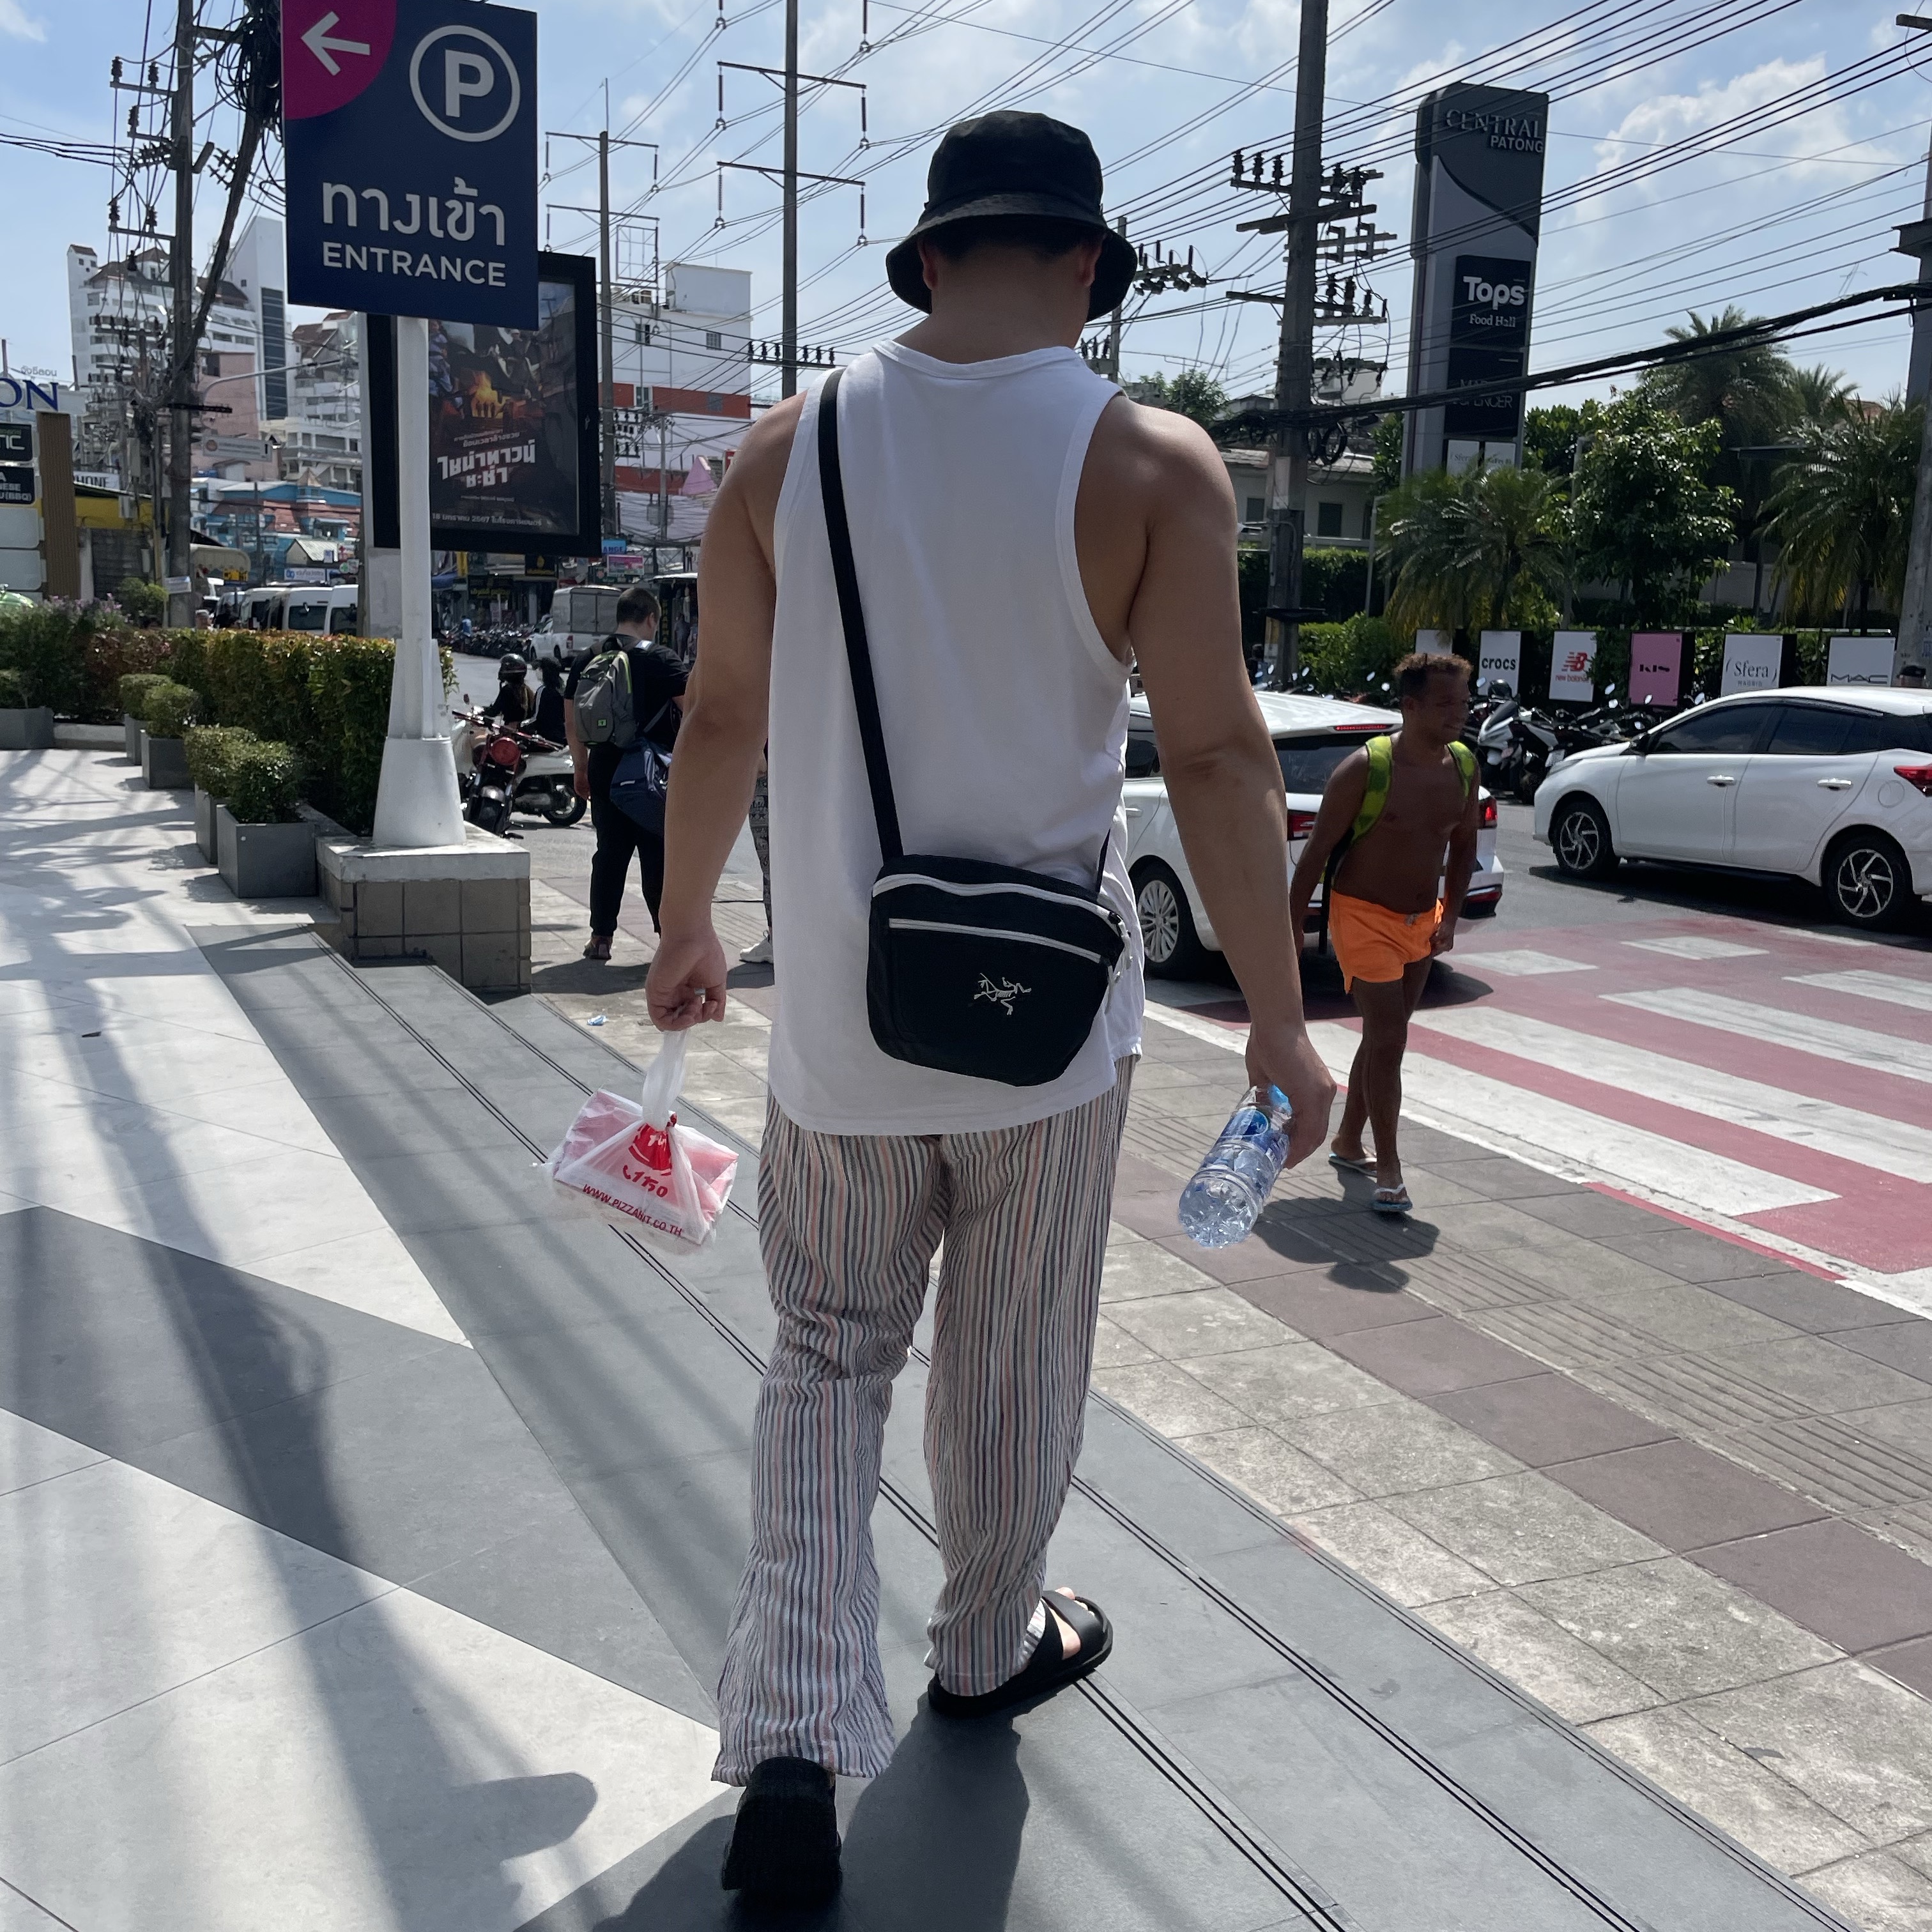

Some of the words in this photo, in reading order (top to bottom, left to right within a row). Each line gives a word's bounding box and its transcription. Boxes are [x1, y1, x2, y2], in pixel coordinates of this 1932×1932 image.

[445, 49, 494, 118] P
[1446, 109, 1544, 139] CENTRAL
[1491, 135, 1544, 153] PATONG
[323, 176, 505, 246] ทางเข้า
[323, 241, 506, 288] ENTRANCE
[1463, 275, 1525, 310] Tops
[1469, 313, 1493, 326] Food
[1495, 316, 1516, 328] Hall
[437, 439, 535, 480] ไชน่าทาวน์
[1482, 657, 1516, 670] crocs
